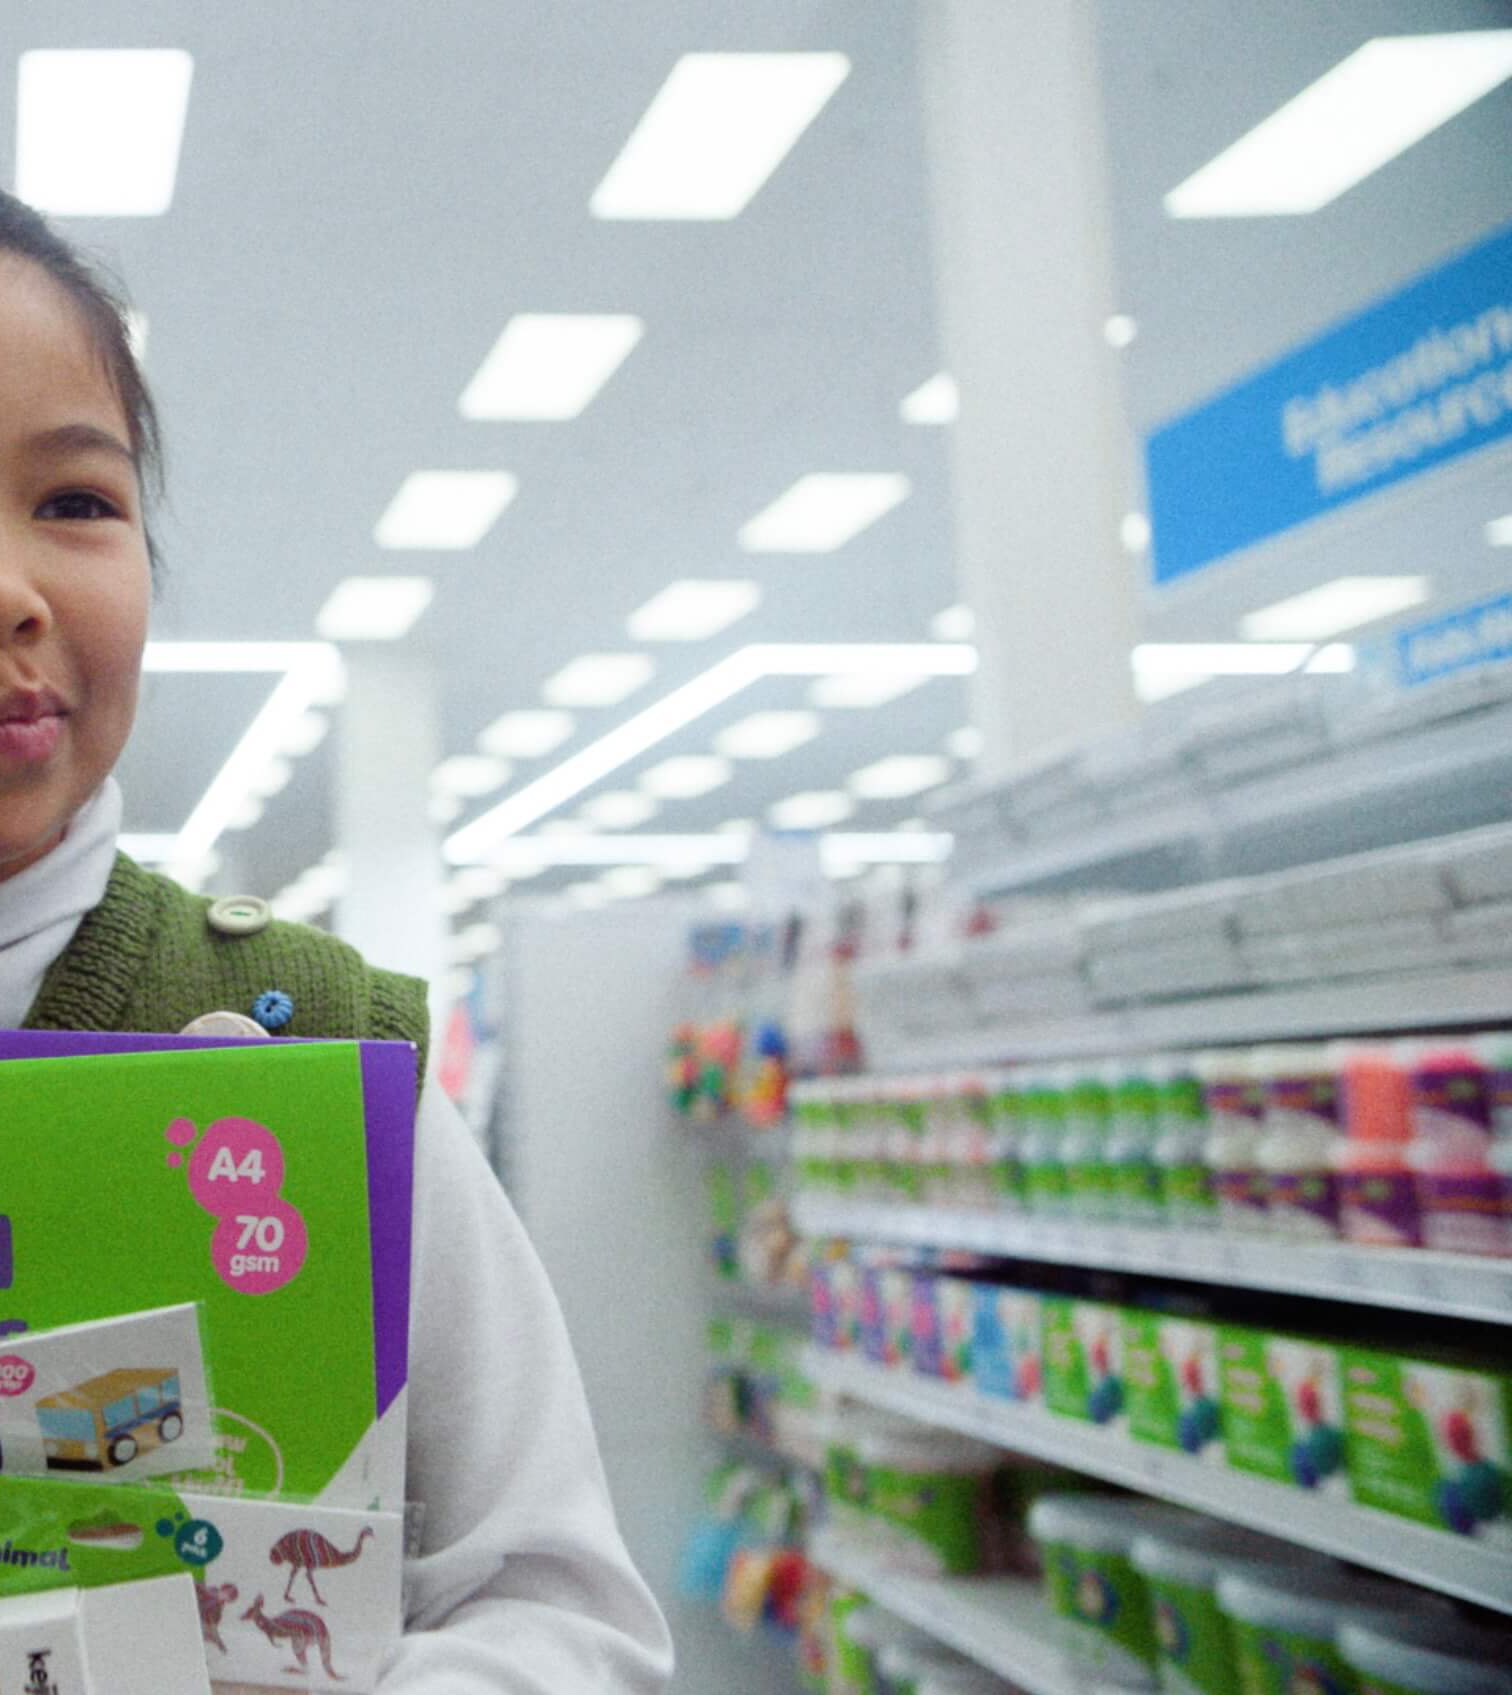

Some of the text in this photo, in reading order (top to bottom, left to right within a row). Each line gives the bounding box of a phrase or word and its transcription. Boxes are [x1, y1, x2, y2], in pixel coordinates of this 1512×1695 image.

[207, 1146, 267, 1185] A4
[235, 1214, 285, 1252] 70
[229, 1254, 281, 1277] gsm
[192, 1526, 210, 1546] 6
